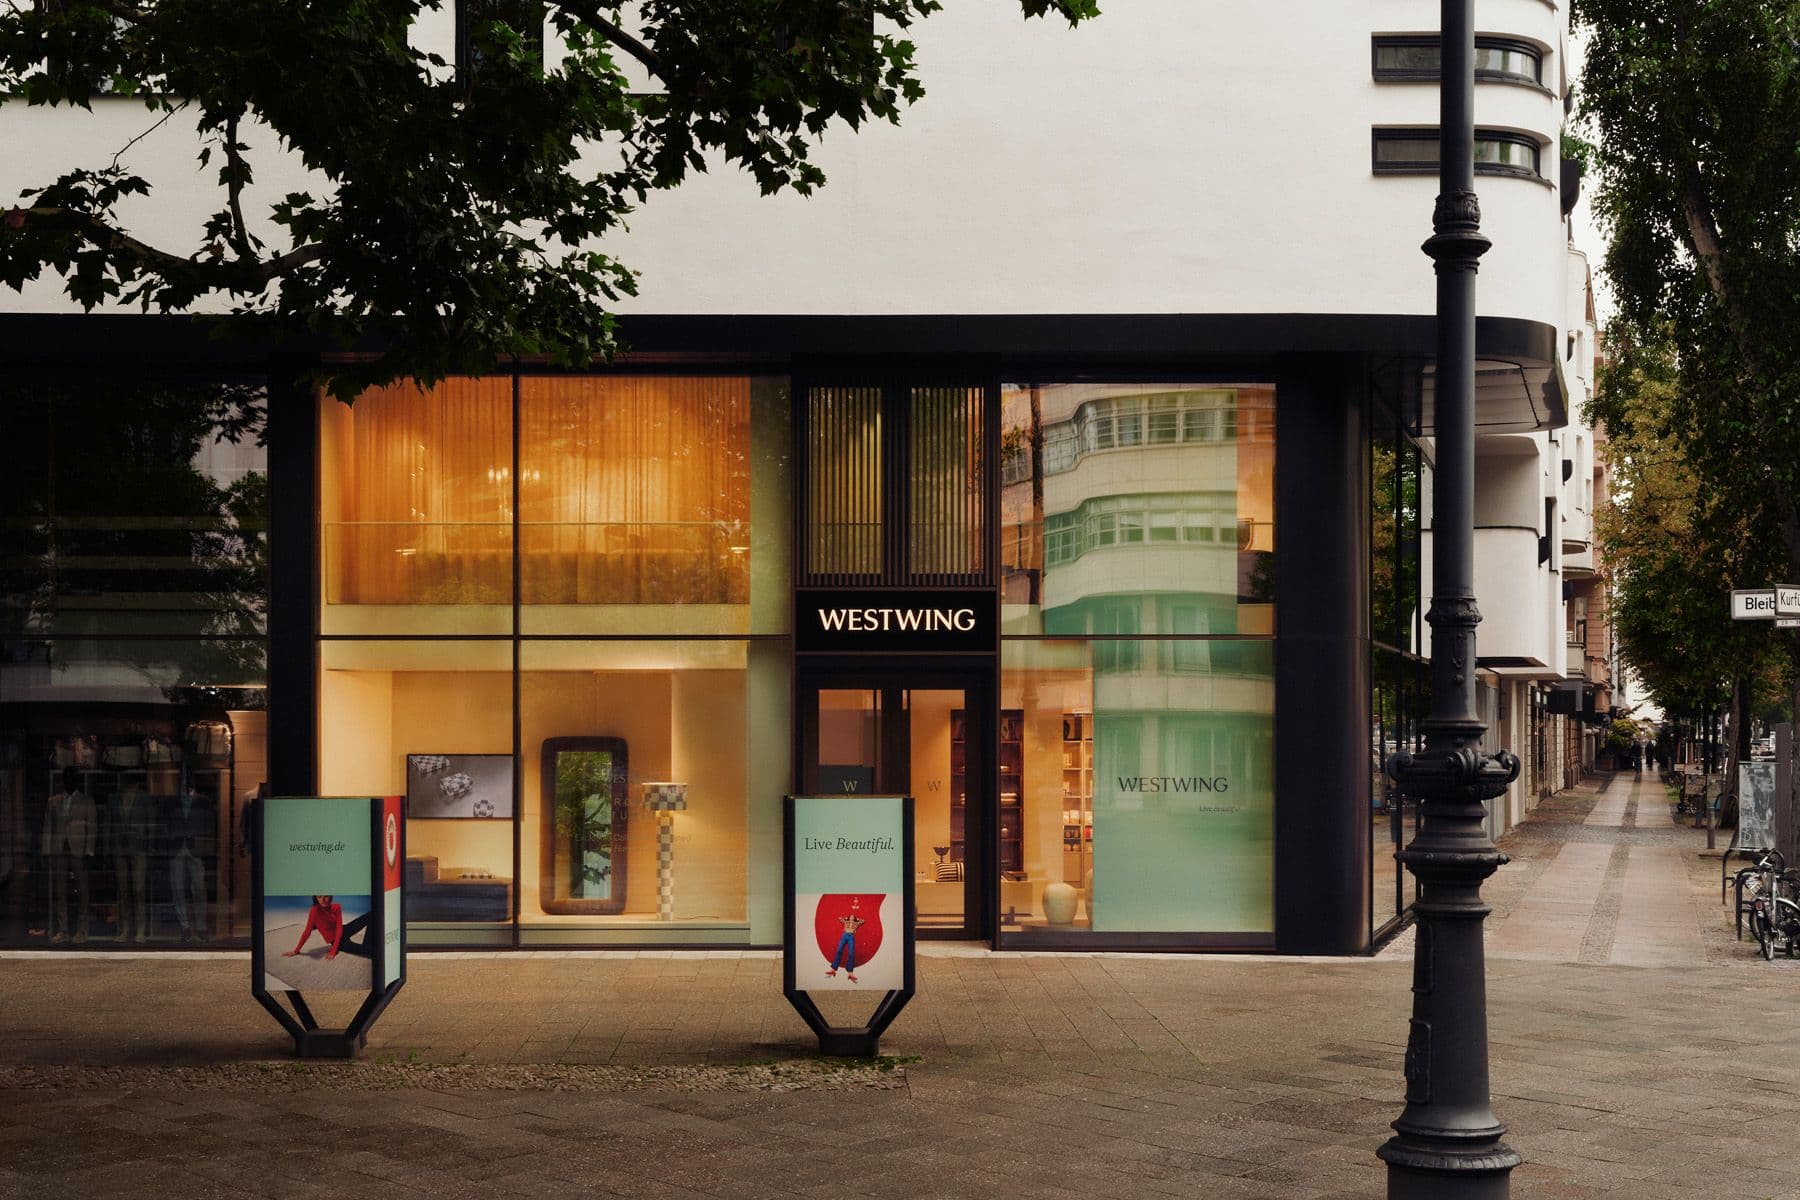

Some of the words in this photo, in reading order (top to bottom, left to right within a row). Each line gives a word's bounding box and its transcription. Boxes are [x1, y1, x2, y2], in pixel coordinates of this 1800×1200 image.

[1745, 596, 1776, 610] Bleib
[818, 608, 976, 631] WESTWING
[843, 780, 858, 792] W
[928, 780, 941, 792] W
[1118, 776, 1229, 793] WESTWING
[289, 840, 345, 855] westwing.de
[805, 837, 833, 850] Live
[836, 837, 895, 854] Beautiful.
